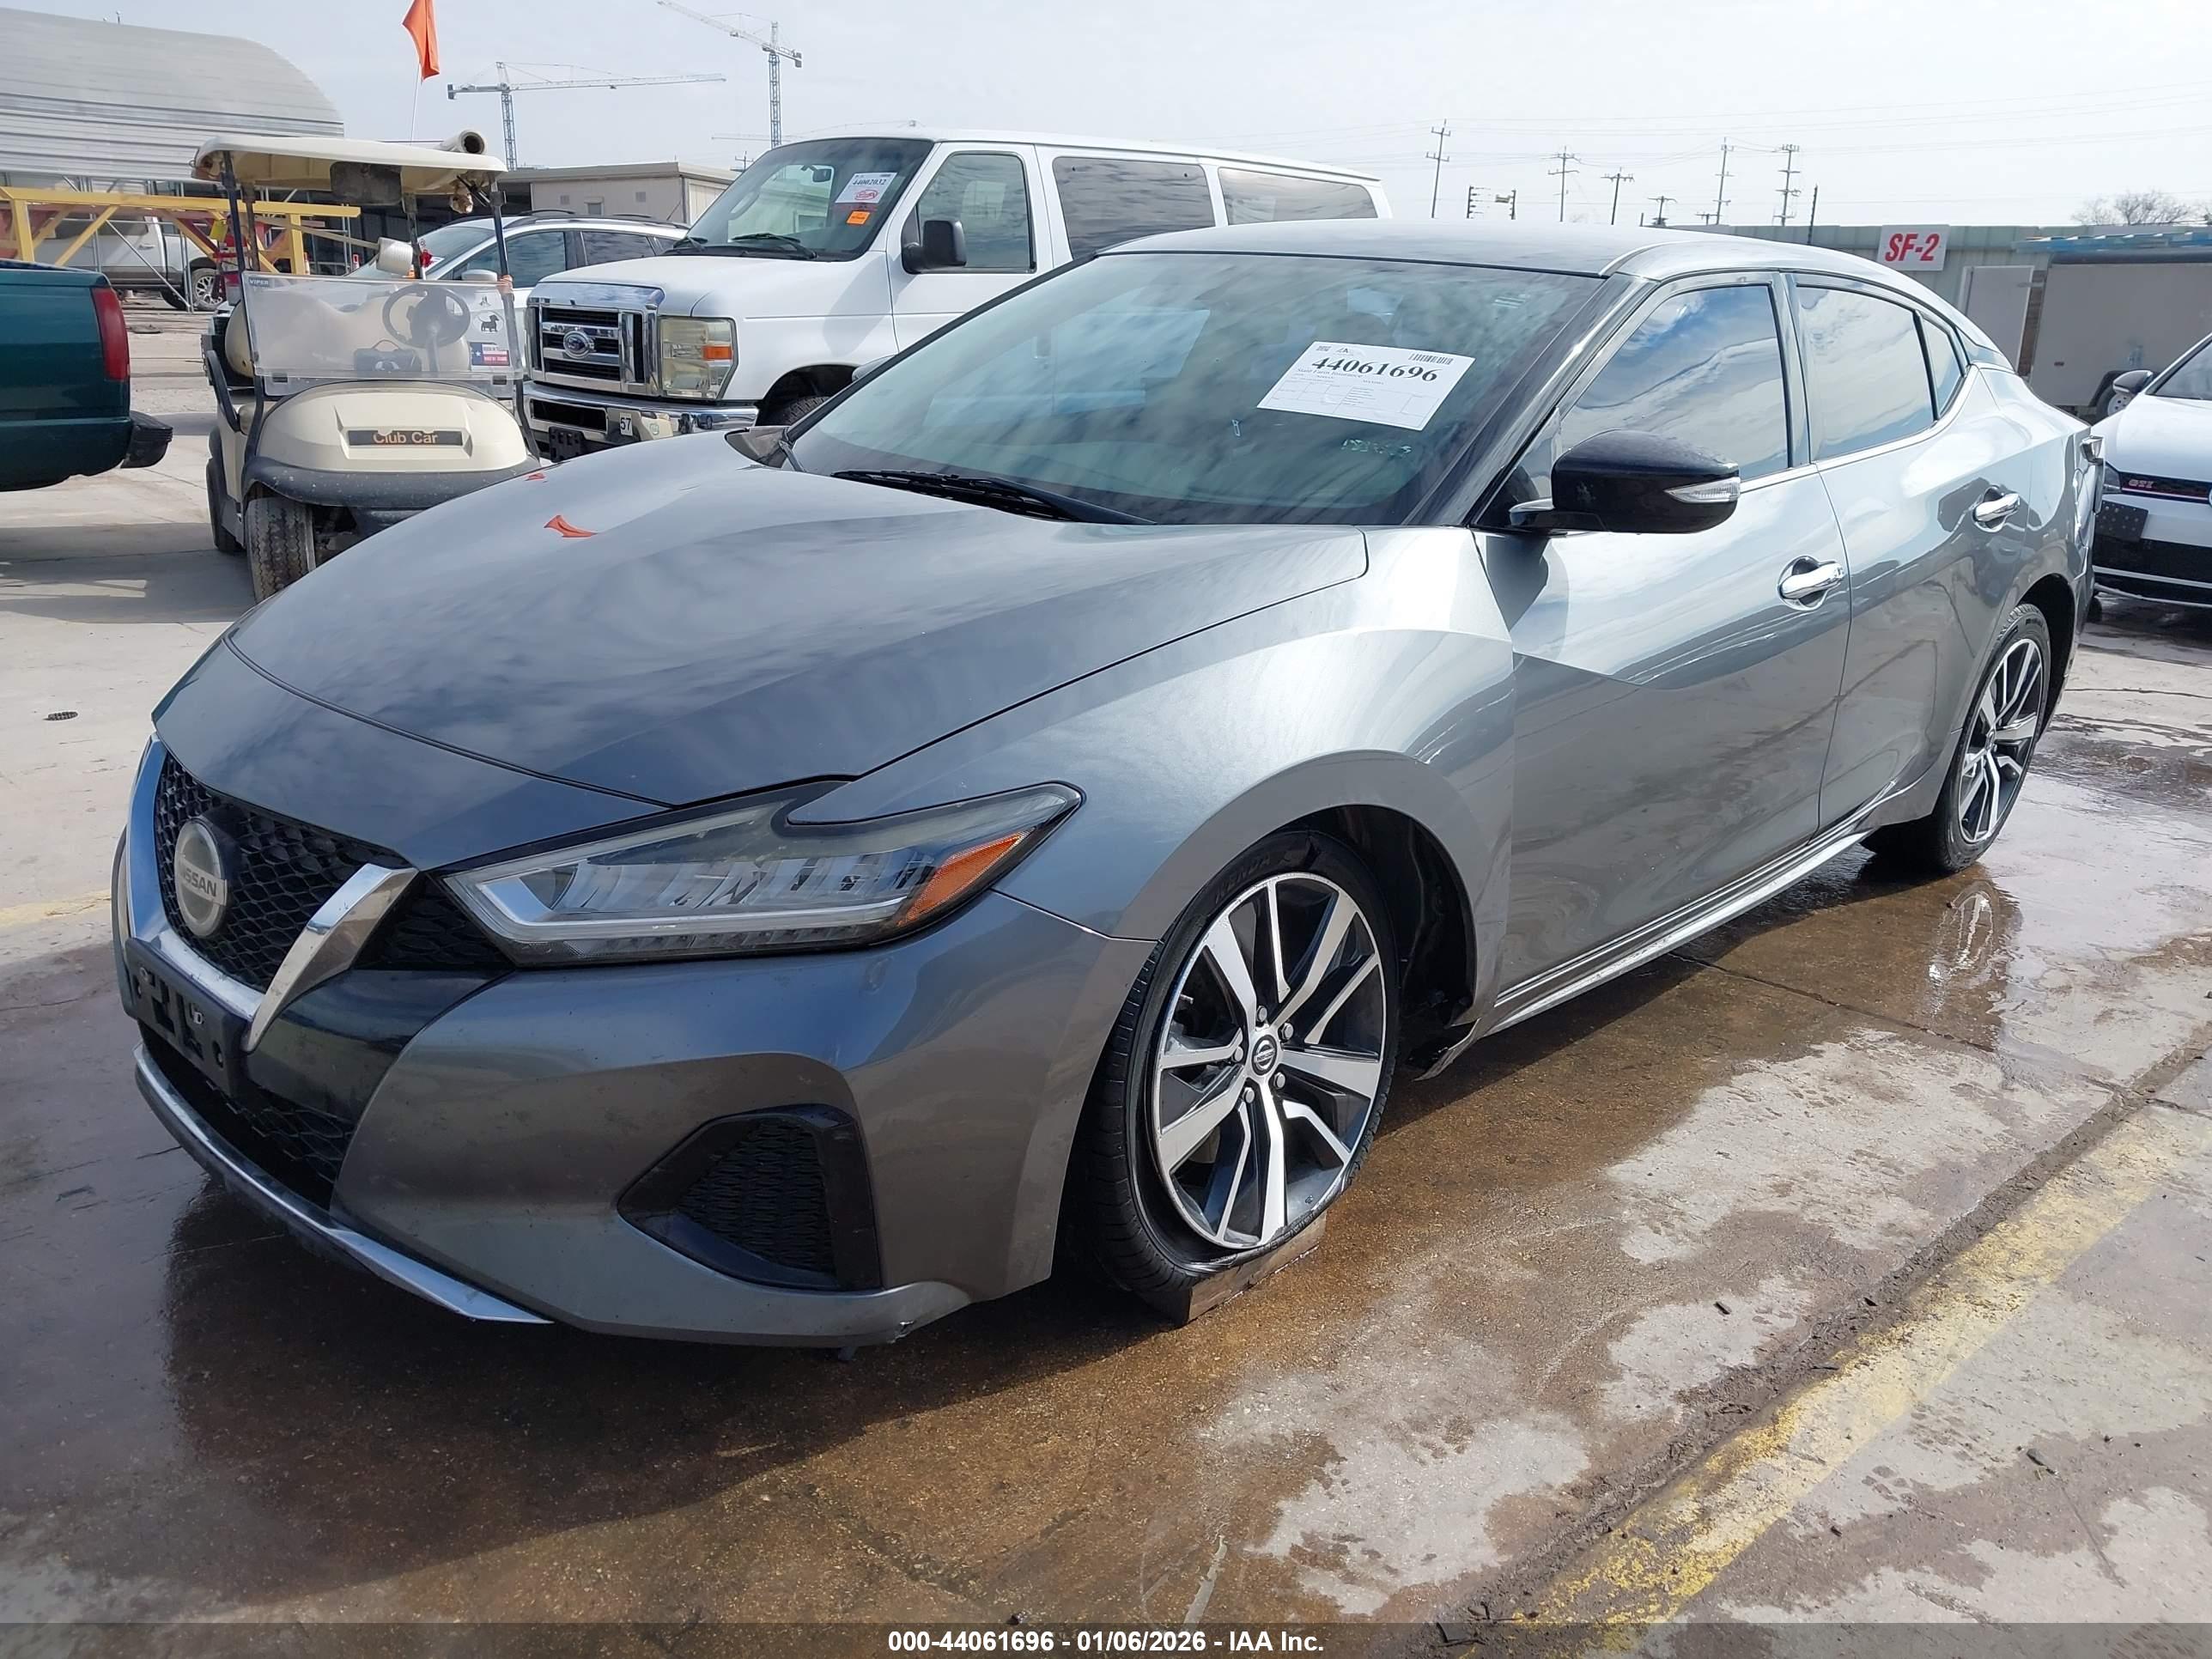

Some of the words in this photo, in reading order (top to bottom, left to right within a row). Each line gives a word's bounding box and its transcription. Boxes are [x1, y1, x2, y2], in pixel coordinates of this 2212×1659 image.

[1885, 233, 1940, 262] SF-2
[1312, 356, 1443, 382] 44061696
[620, 417, 632, 431] 57
[373, 431, 407, 444] Club
[411, 431, 438, 444] Car
[2129, 478, 2154, 489] GTI
